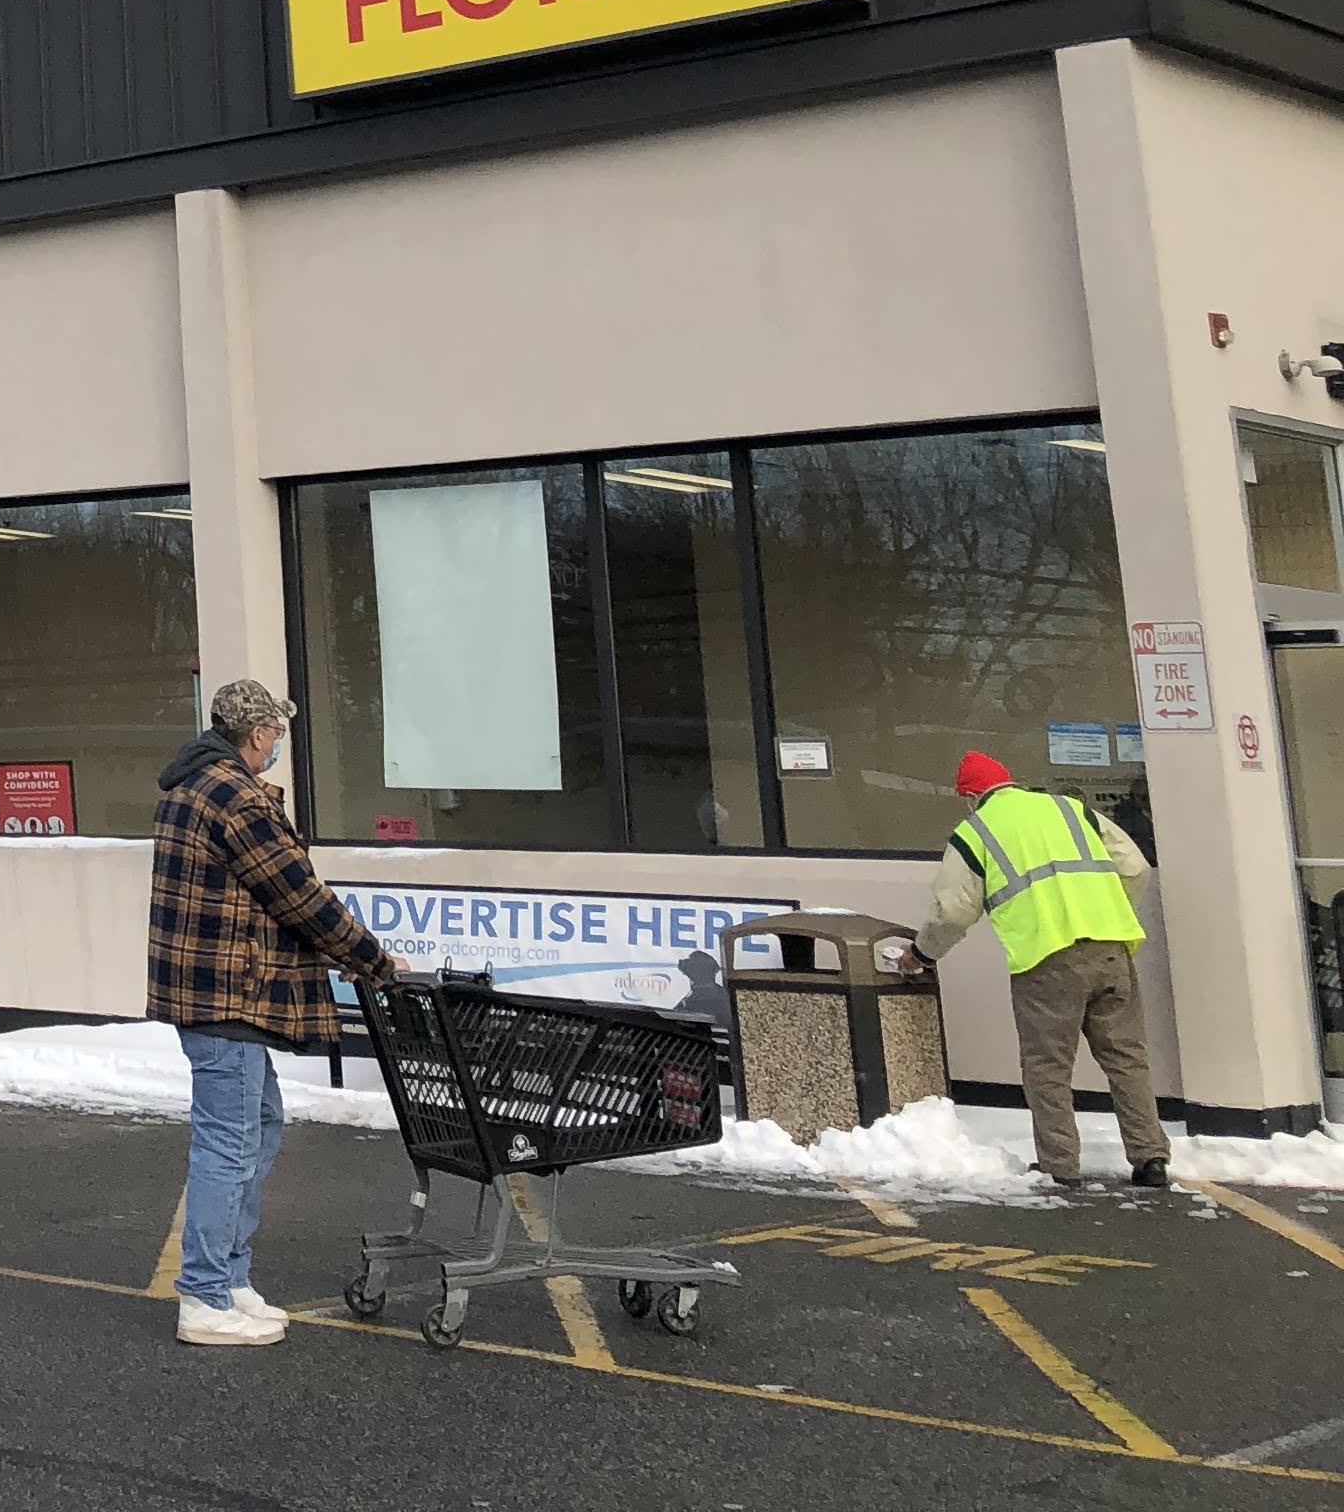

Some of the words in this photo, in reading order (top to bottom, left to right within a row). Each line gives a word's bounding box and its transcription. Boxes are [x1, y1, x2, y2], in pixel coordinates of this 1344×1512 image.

[1132, 628, 1154, 650] NO
[1156, 631, 1201, 646] STANDING
[1154, 663, 1190, 680] FIRE
[1154, 684, 1197, 703] ZONE
[3, 780, 60, 790] CONFIDENCE
[5, 771, 31, 780] SHOP
[32, 770, 57, 780] WITH
[627, 905, 770, 954] HERE
[382, 938, 437, 956] DCORP
[439, 941, 561, 963] adcorpmg.com
[613, 972, 668, 997] adcorp
